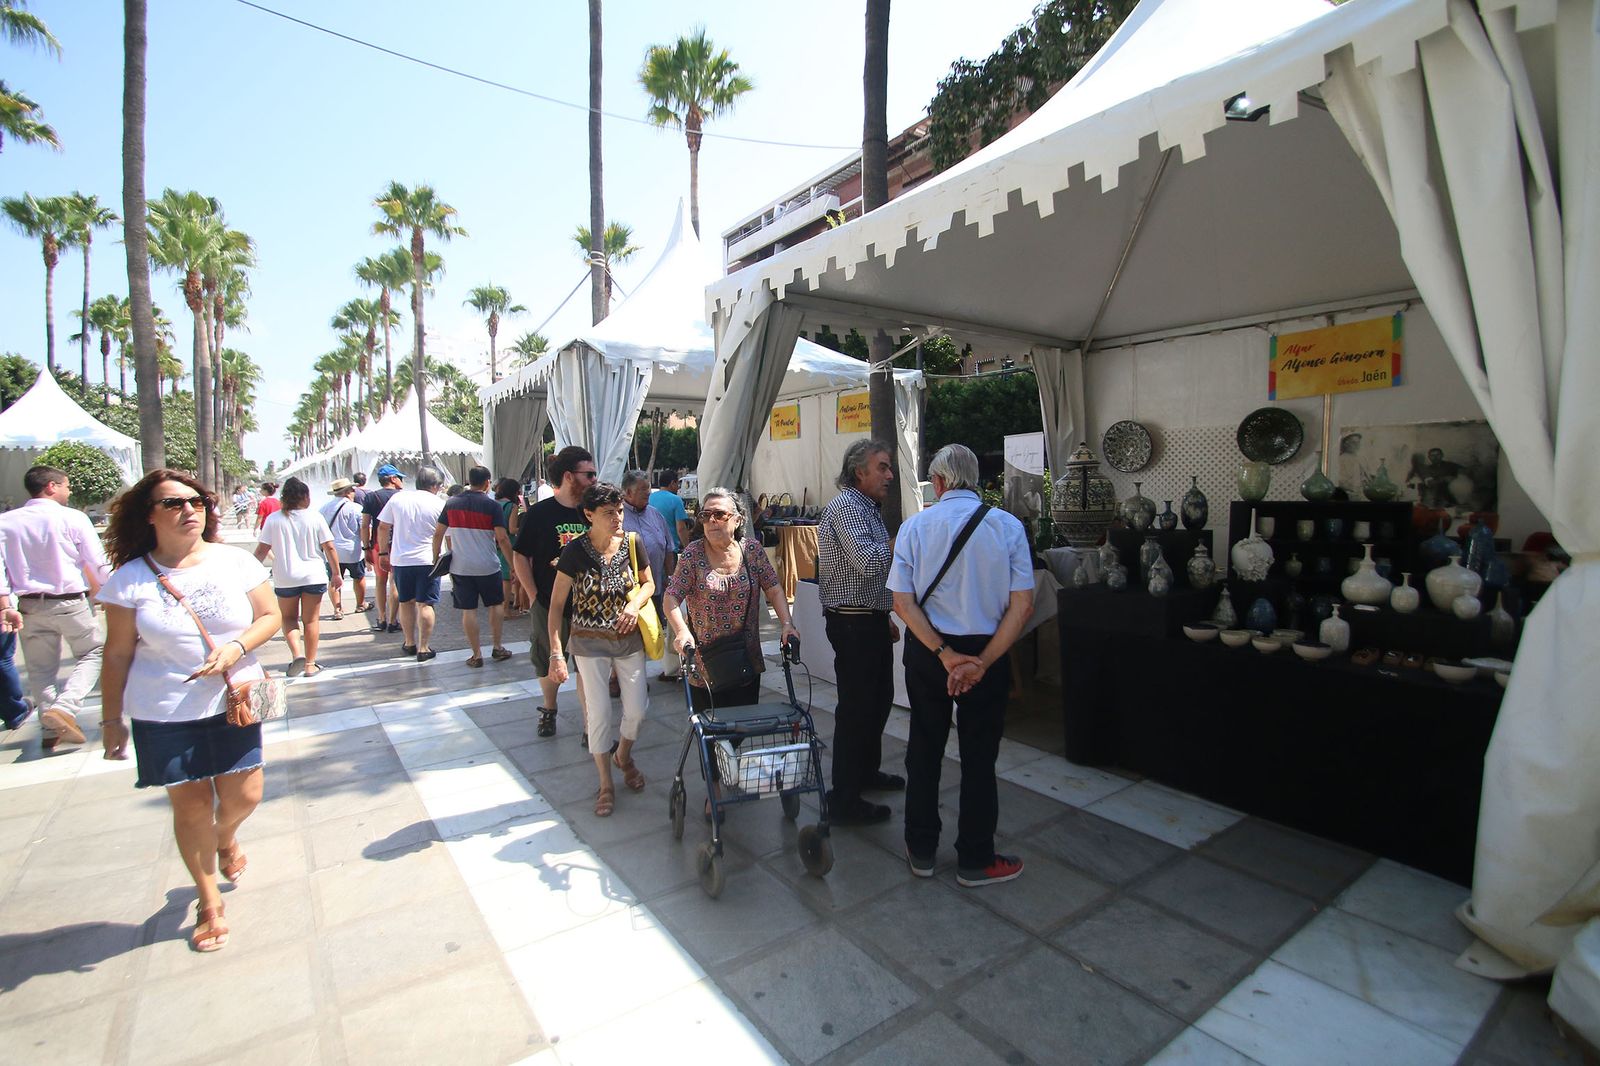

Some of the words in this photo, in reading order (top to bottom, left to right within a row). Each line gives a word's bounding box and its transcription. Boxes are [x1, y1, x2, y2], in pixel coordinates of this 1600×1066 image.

[1283, 344, 1316, 356] Alfar
[1281, 357, 1327, 373] Alfonso
[1360, 369, 1388, 383] Jaén
